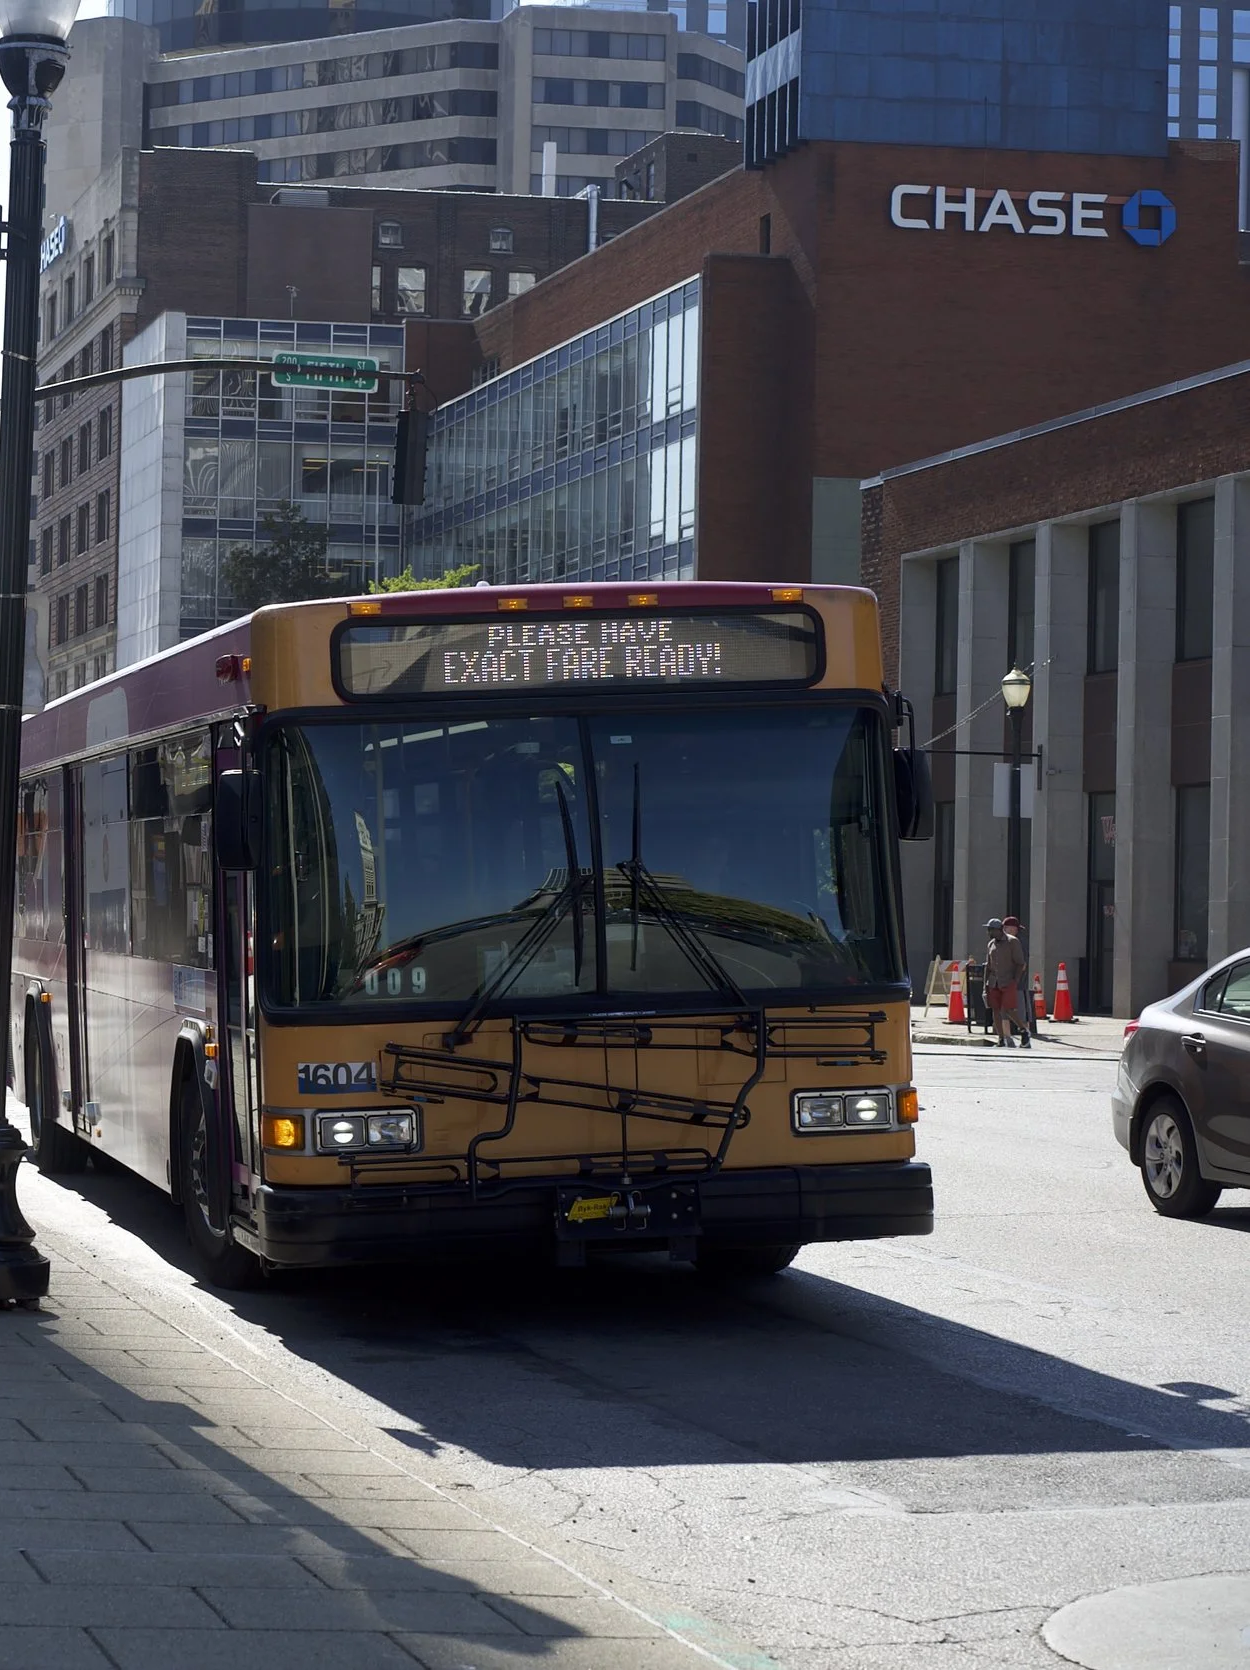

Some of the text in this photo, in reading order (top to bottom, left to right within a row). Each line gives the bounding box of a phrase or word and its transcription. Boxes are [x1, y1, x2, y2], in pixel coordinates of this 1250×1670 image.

[891, 184, 1108, 237] CHASE
[488, 621, 672, 647] PLEASE HAVE
[444, 643, 721, 684] EXACT FARE READY!
[298, 1062, 372, 1091] 1604
